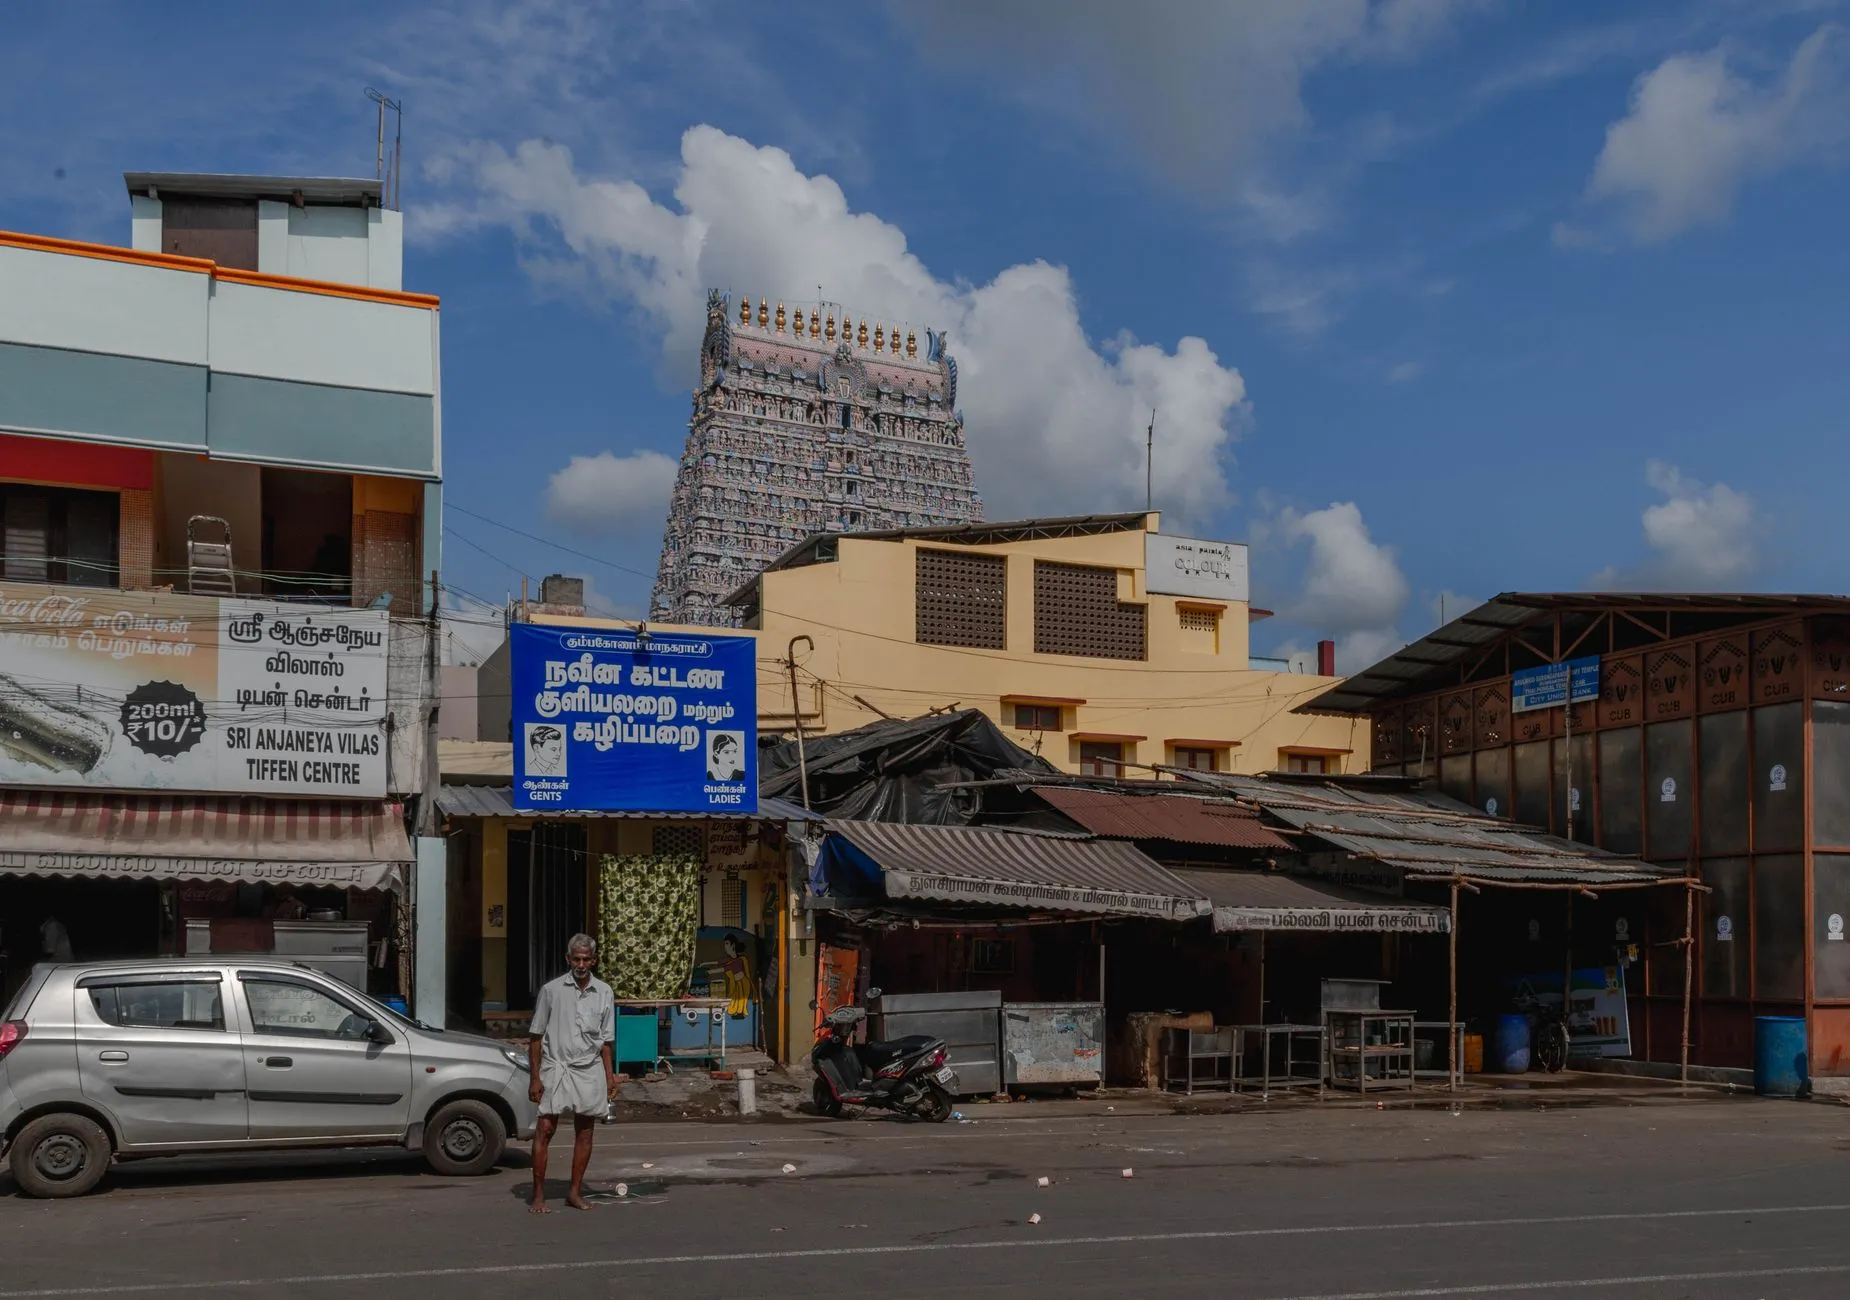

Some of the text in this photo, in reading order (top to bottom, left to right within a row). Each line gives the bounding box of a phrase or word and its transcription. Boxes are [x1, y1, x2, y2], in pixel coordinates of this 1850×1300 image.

[269, 617, 381, 651] ஆஞ்சநேய
[78, 630, 196, 661] பெறுங்கள்
[266, 651, 344, 677] விலாஸ்
[545, 652, 725, 690] நவீன கட்டண
[236, 682, 288, 712] டிபன்
[1530, 695, 1545, 704] CITY
[1572, 688, 1592, 697] BANK
[1711, 690, 1735, 705] CUB
[1764, 682, 1790, 697] CUB
[128, 701, 195, 720] 200ml
[535, 685, 735, 724] குளியலறை மற்றும்
[1657, 700, 1680, 714] CUB
[1609, 708, 1631, 721] CUB
[227, 727, 379, 756] SRI ANJANEYA VILAS
[573, 715, 700, 752] கழிப்பறை
[247, 758, 360, 784] TIFFEN CENTRE
[523, 778, 570, 791] ஆண்கள்
[704, 783, 747, 794] பெண்கள்
[530, 791, 562, 801] GENTS
[709, 794, 741, 804] LADIES
[1073, 891, 1080, 902] &
[1272, 911, 1331, 928] பல்லவி
[1334, 911, 1375, 930] டிபன்
